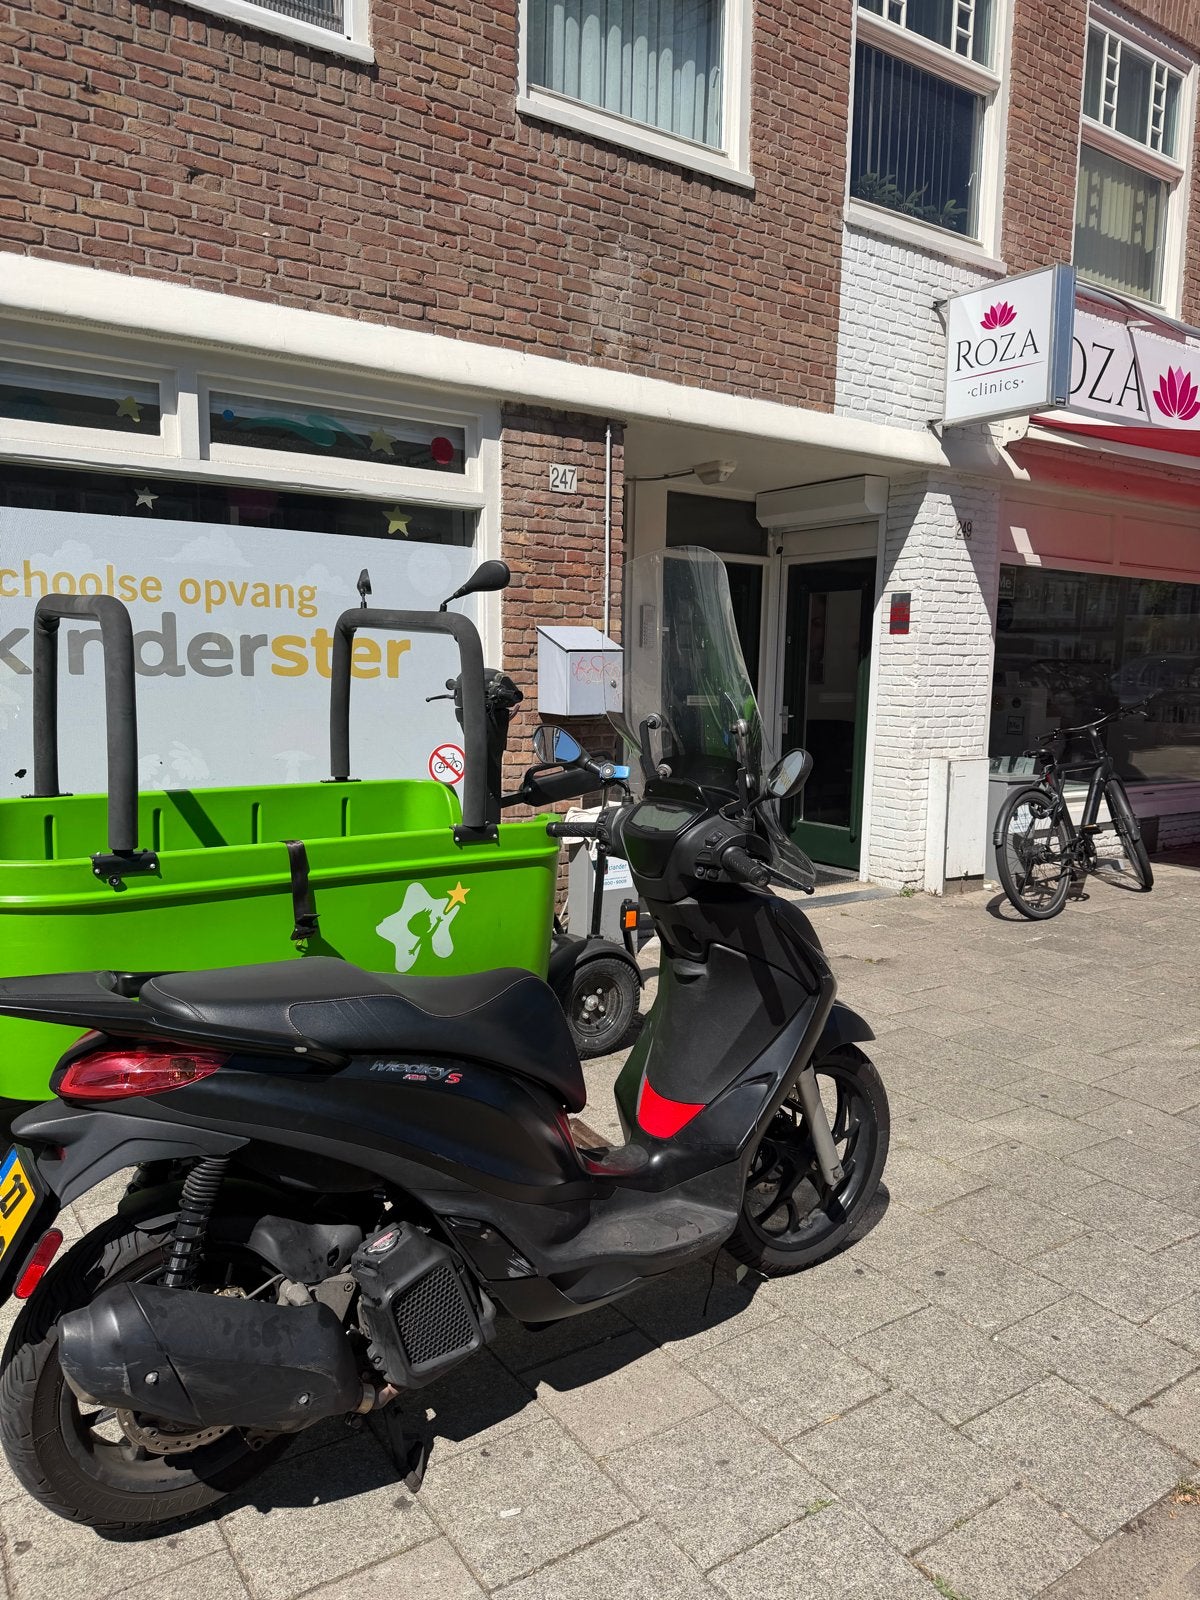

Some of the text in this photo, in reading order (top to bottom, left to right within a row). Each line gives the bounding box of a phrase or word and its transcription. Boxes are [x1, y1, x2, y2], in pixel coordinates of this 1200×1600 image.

[955, 328, 1040, 372] ROZA
[551, 467, 577, 490] 247
[956, 520, 972, 538] 249
[179, 577, 318, 618] opvang
[445, 1073, 463, 1084] S
